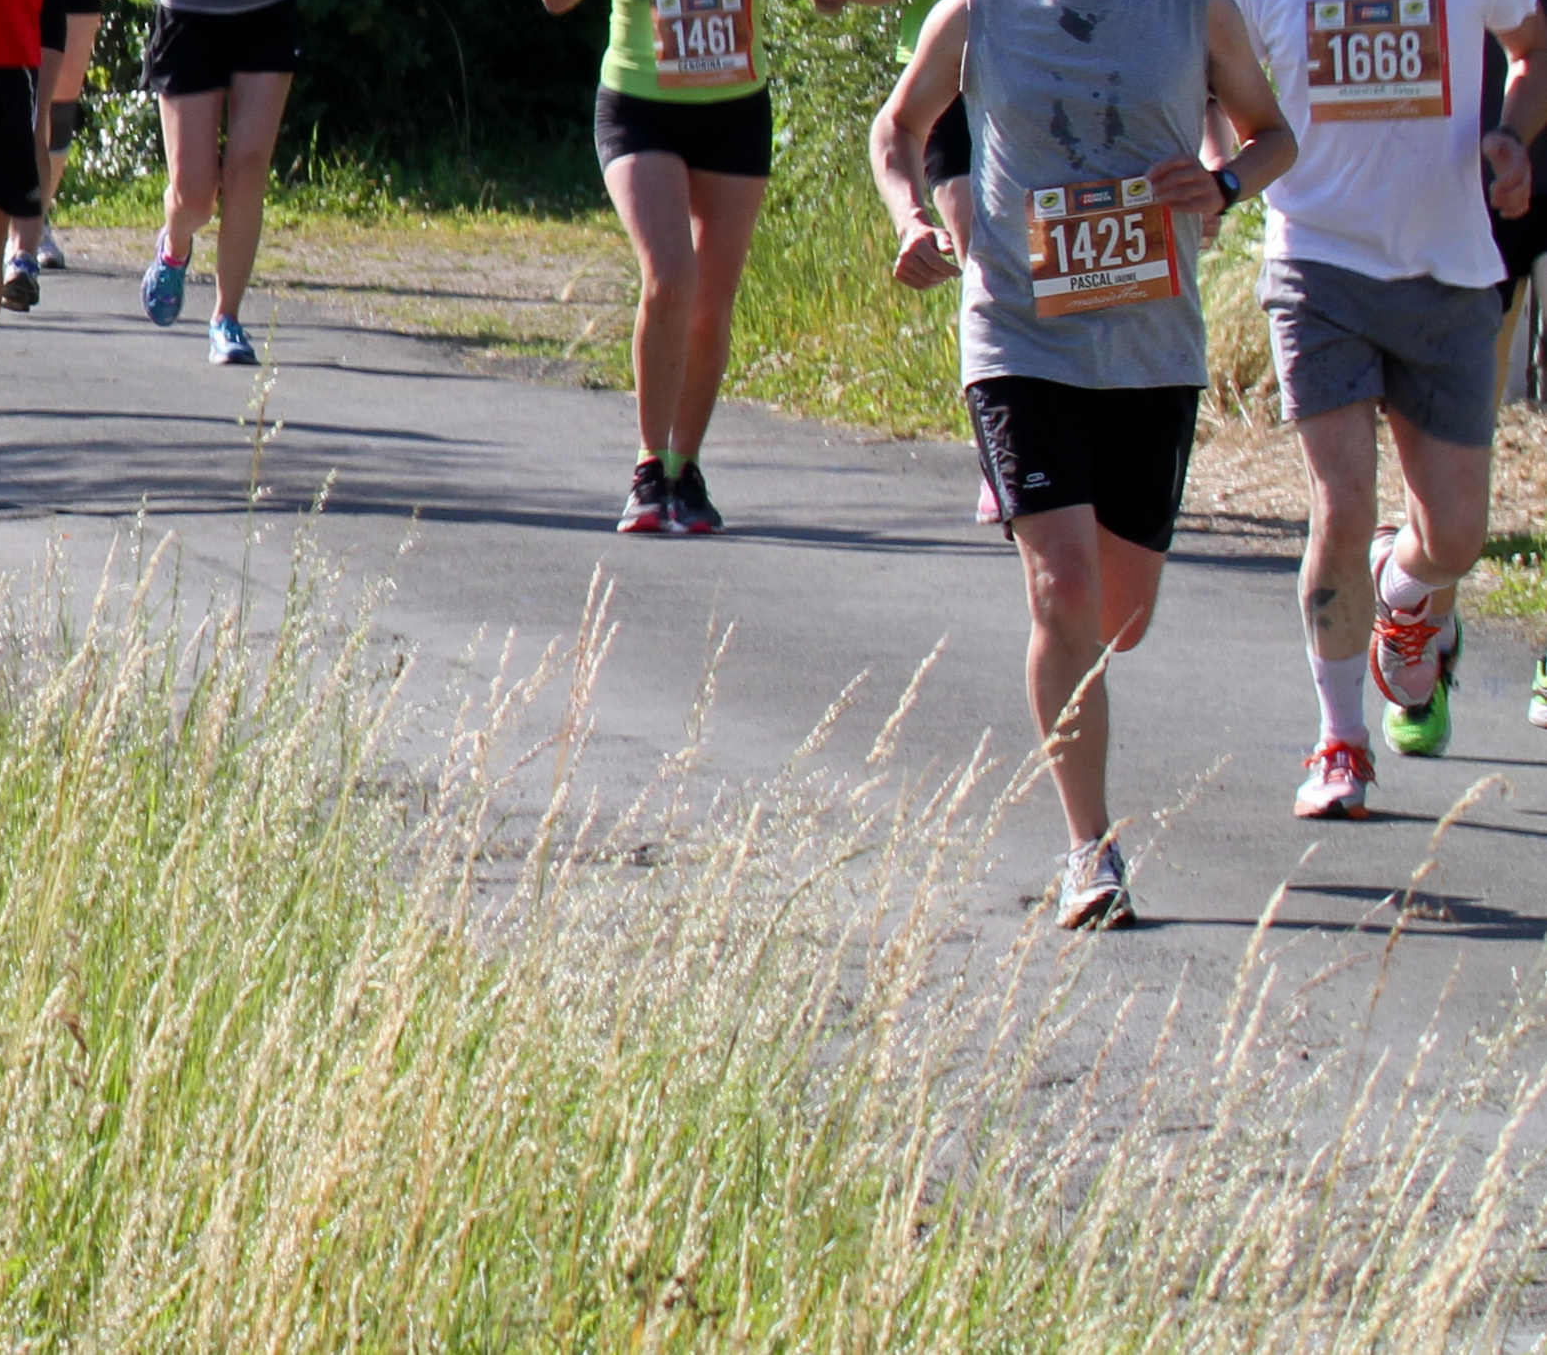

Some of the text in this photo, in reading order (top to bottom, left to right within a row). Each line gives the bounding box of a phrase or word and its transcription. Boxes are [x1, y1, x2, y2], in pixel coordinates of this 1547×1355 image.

[671, 15, 736, 58] 1461
[1327, 30, 1422, 83] 1668
[1049, 212, 1147, 274] 1425
[1070, 272, 1113, 291] PASCAL
